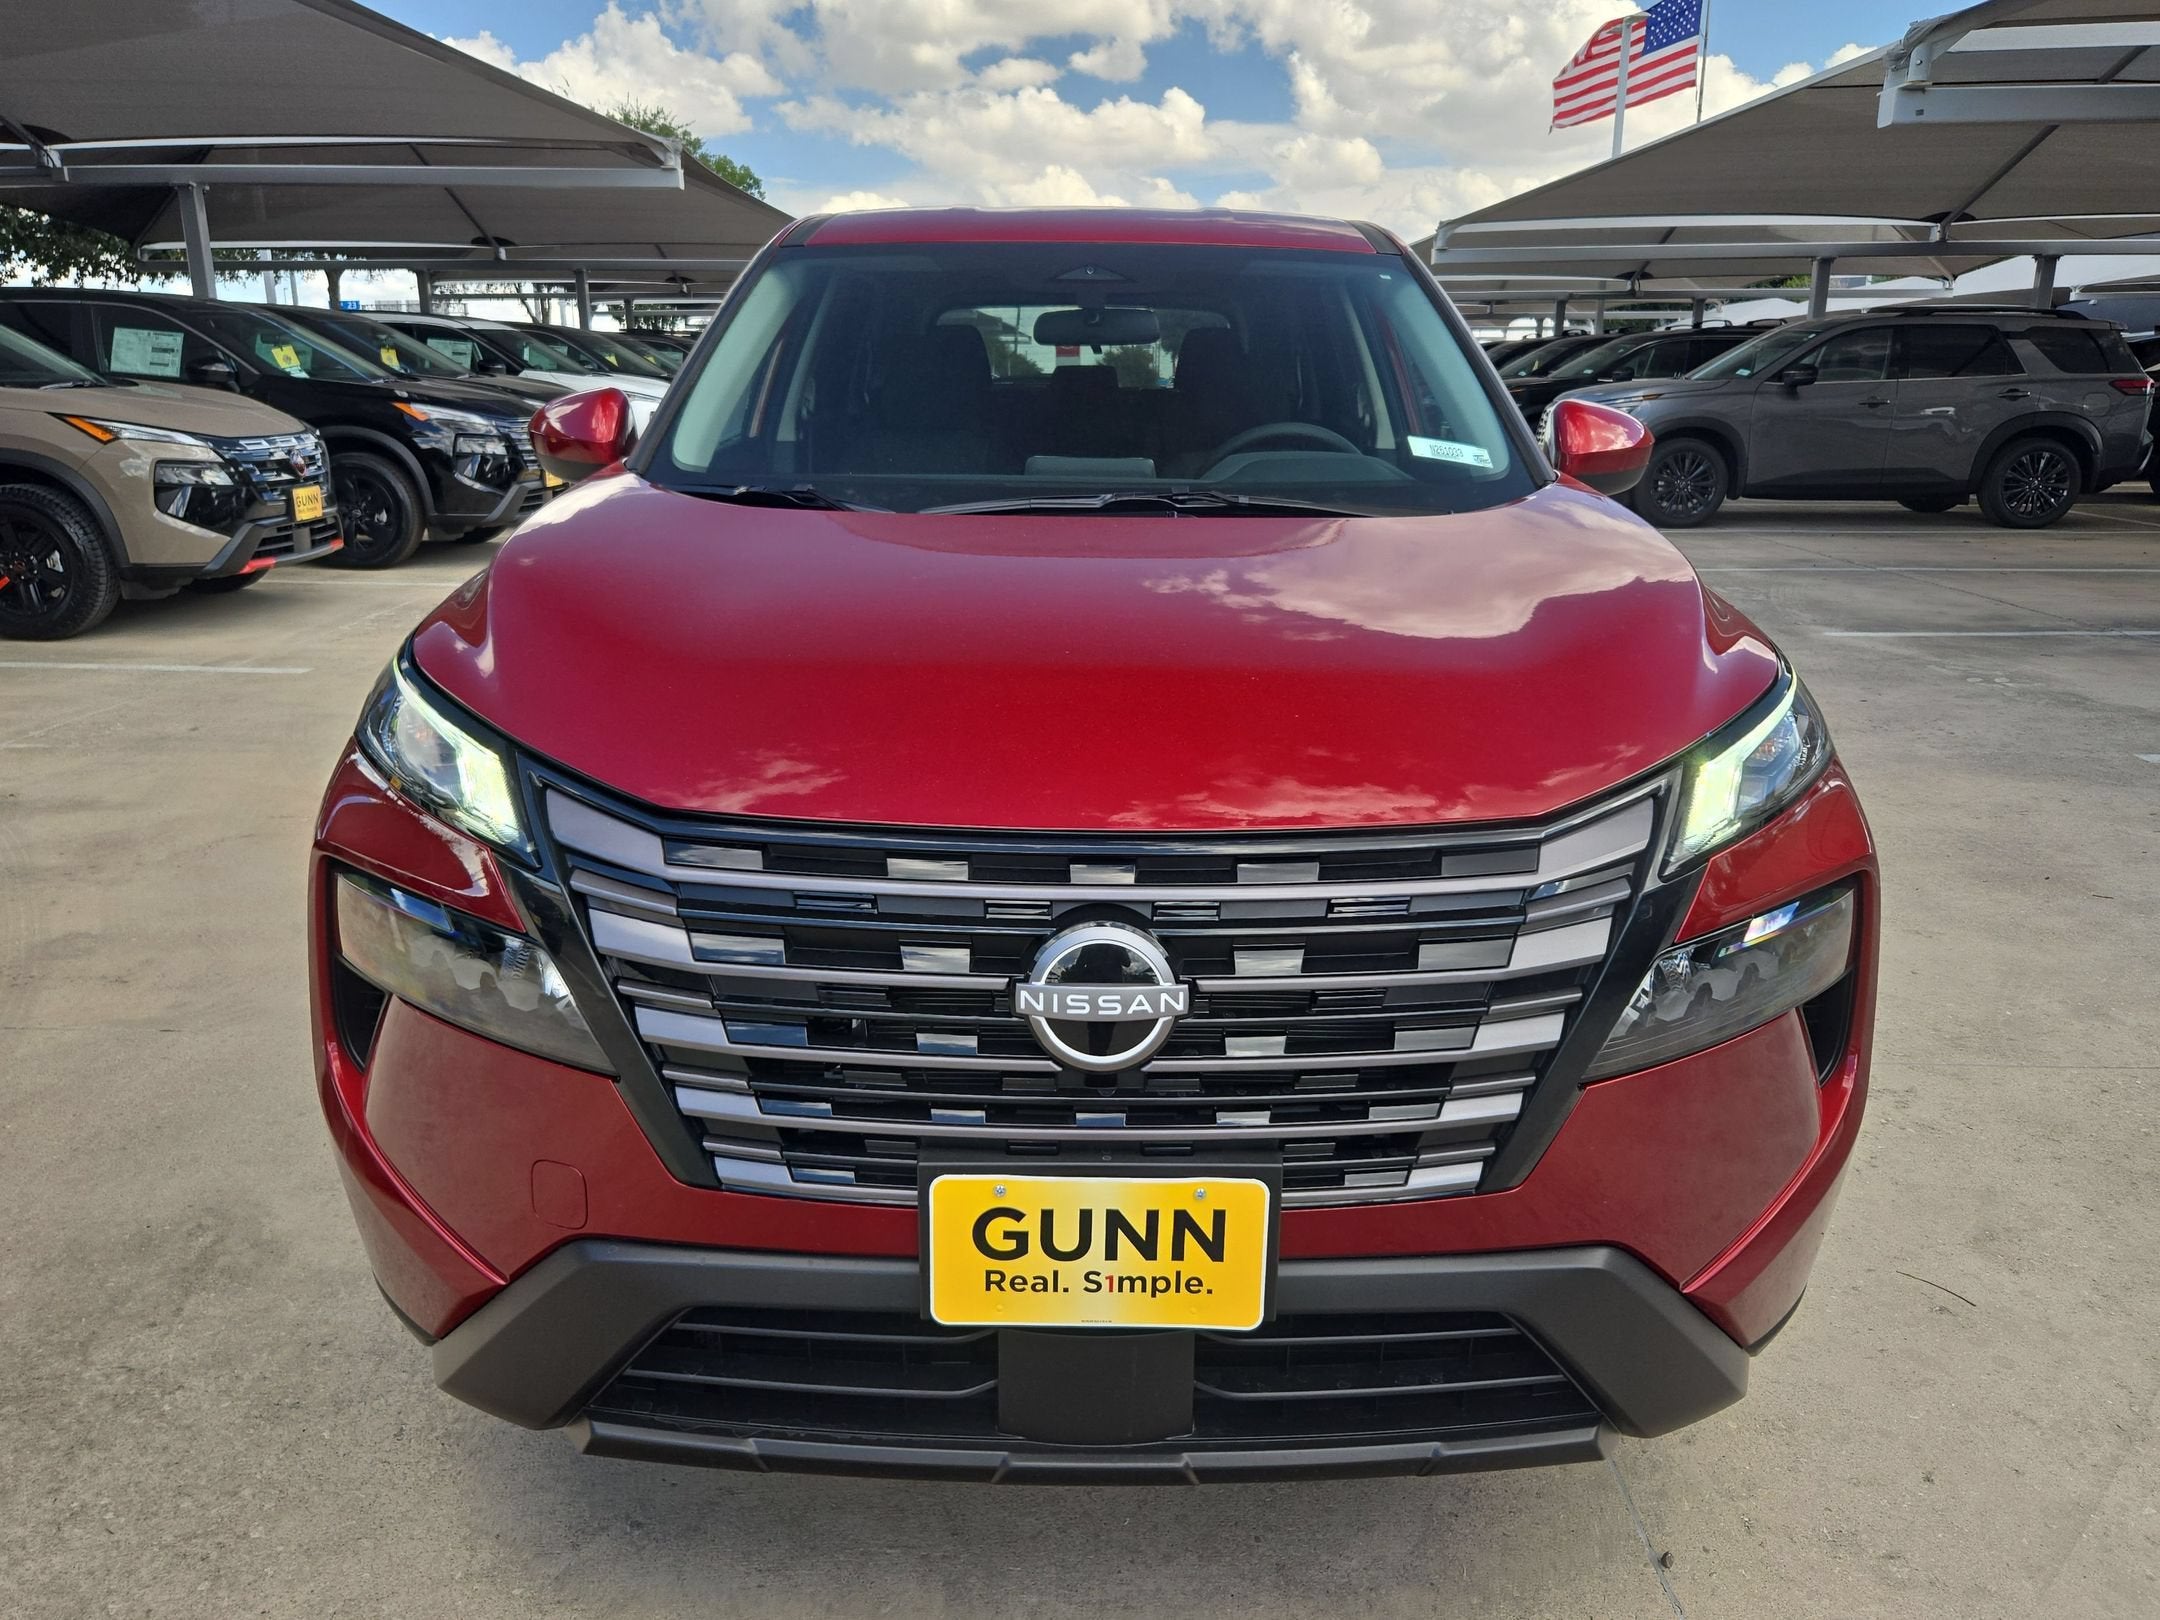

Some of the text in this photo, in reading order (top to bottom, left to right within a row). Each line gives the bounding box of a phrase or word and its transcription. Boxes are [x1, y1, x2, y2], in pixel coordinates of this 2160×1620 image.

[296, 492, 319, 508] GUNN
[1020, 990, 1184, 1015] NISSAN
[971, 1206, 1226, 1263] GUNN
[985, 1269, 1213, 1298] Real. S1mple.
